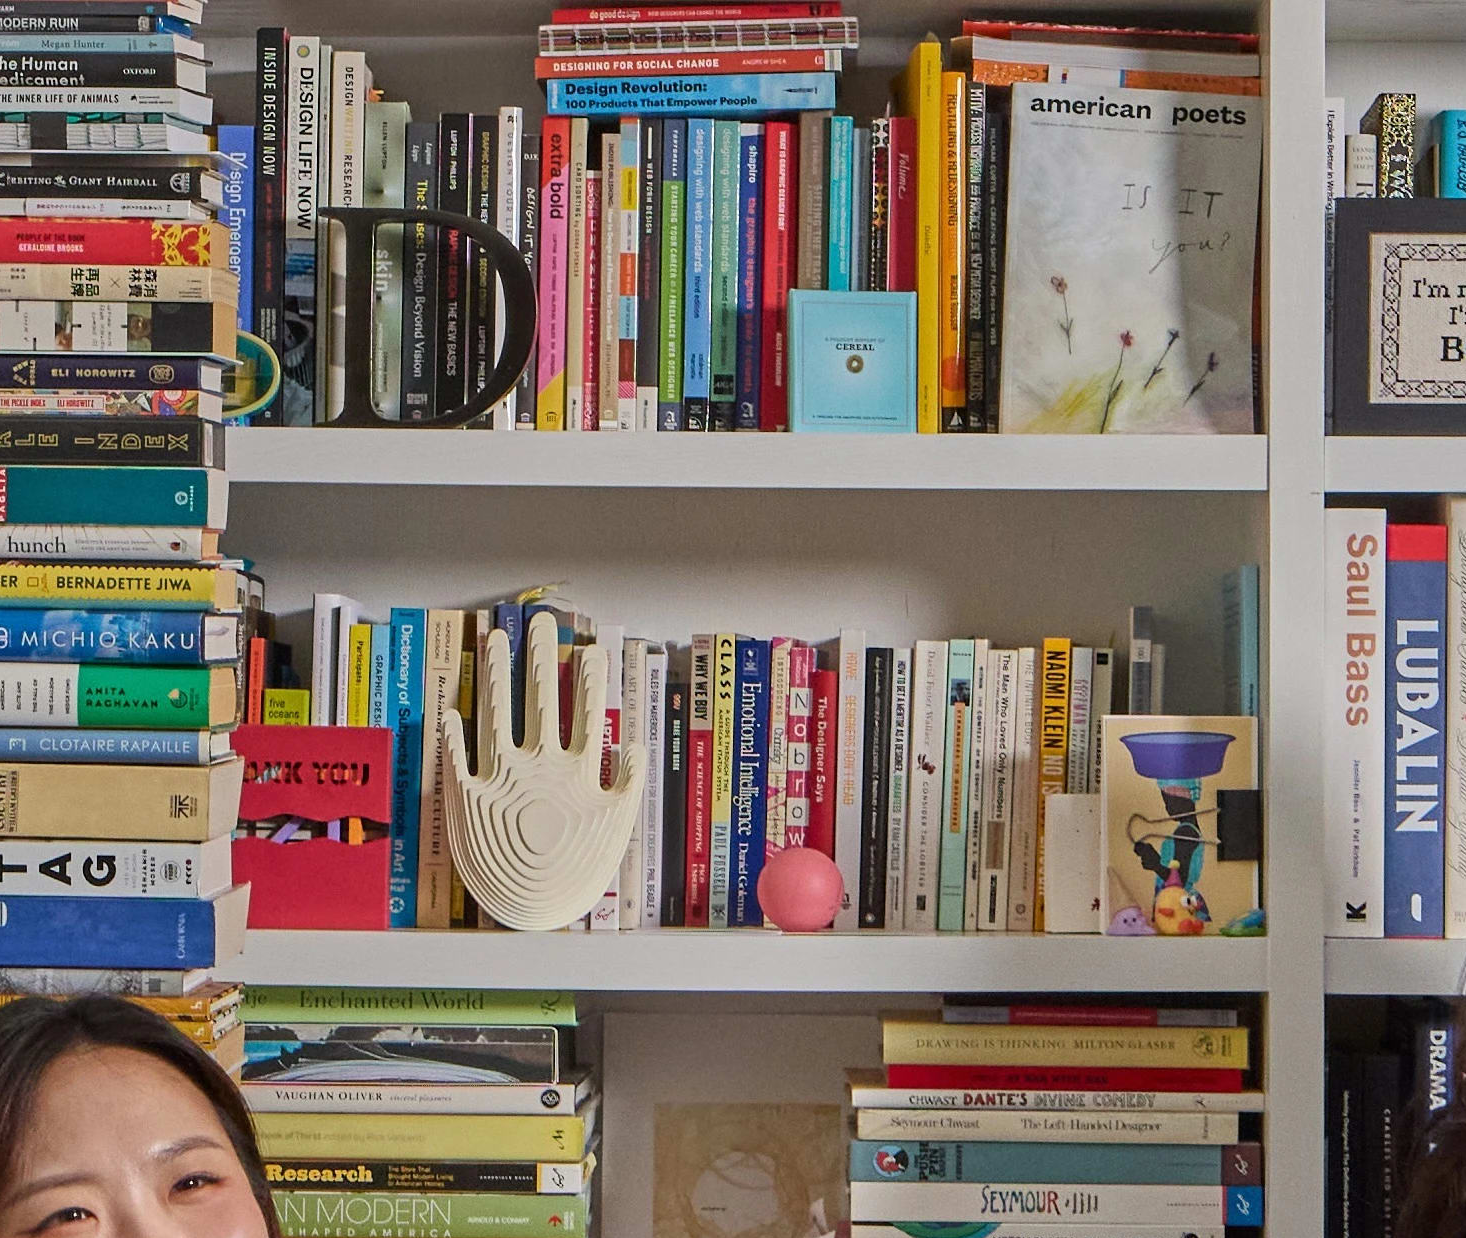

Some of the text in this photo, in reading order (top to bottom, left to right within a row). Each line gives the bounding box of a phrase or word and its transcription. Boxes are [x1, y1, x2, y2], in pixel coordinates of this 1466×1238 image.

[48, 18, 79, 29] RUIN
[21, 57, 78, 71] Human
[553, 58, 719, 72] DESIGNING FOR SOCIAL CHANGE
[565, 80, 708, 97] Design Revolution:
[262, 46, 277, 176] INSIDE DESIGN NOW
[565, 96, 757, 110] 100 Products That Empower People
[1030, 96, 1247, 127] american poets
[297, 67, 315, 230] DESIGN LIFE NOW
[549, 134, 564, 219] extra bold
[1122, 183, 1223, 218] IS IT
[1149, 232, 1230, 275] you?
[1412, 278, 1450, 298] I'm
[835, 343, 875, 352] CEREAL
[75, 433, 188, 450] INDEX
[7, 536, 67, 553] hunch
[57, 576, 191, 591] BERNADETTE JIWA
[22, 631, 194, 649] MICHIO KAKU
[1346, 533, 1379, 727] Saul Bass
[1042, 650, 1066, 749] NAOMI KLEIN
[1395, 619, 1440, 833] LUBALIN
[39, 738, 191, 753] CLOTAIRE RAPAILLE
[816, 696, 828, 803] The Designer Says
[739, 680, 762, 837] Emotional Intelligence
[300, 990, 484, 1011] Enchanted World
[276, 1090, 383, 1101] VAUGHAN OLIVER
[267, 1165, 373, 1182] Research
[980, 1185, 1060, 1216] SEYMOUR
